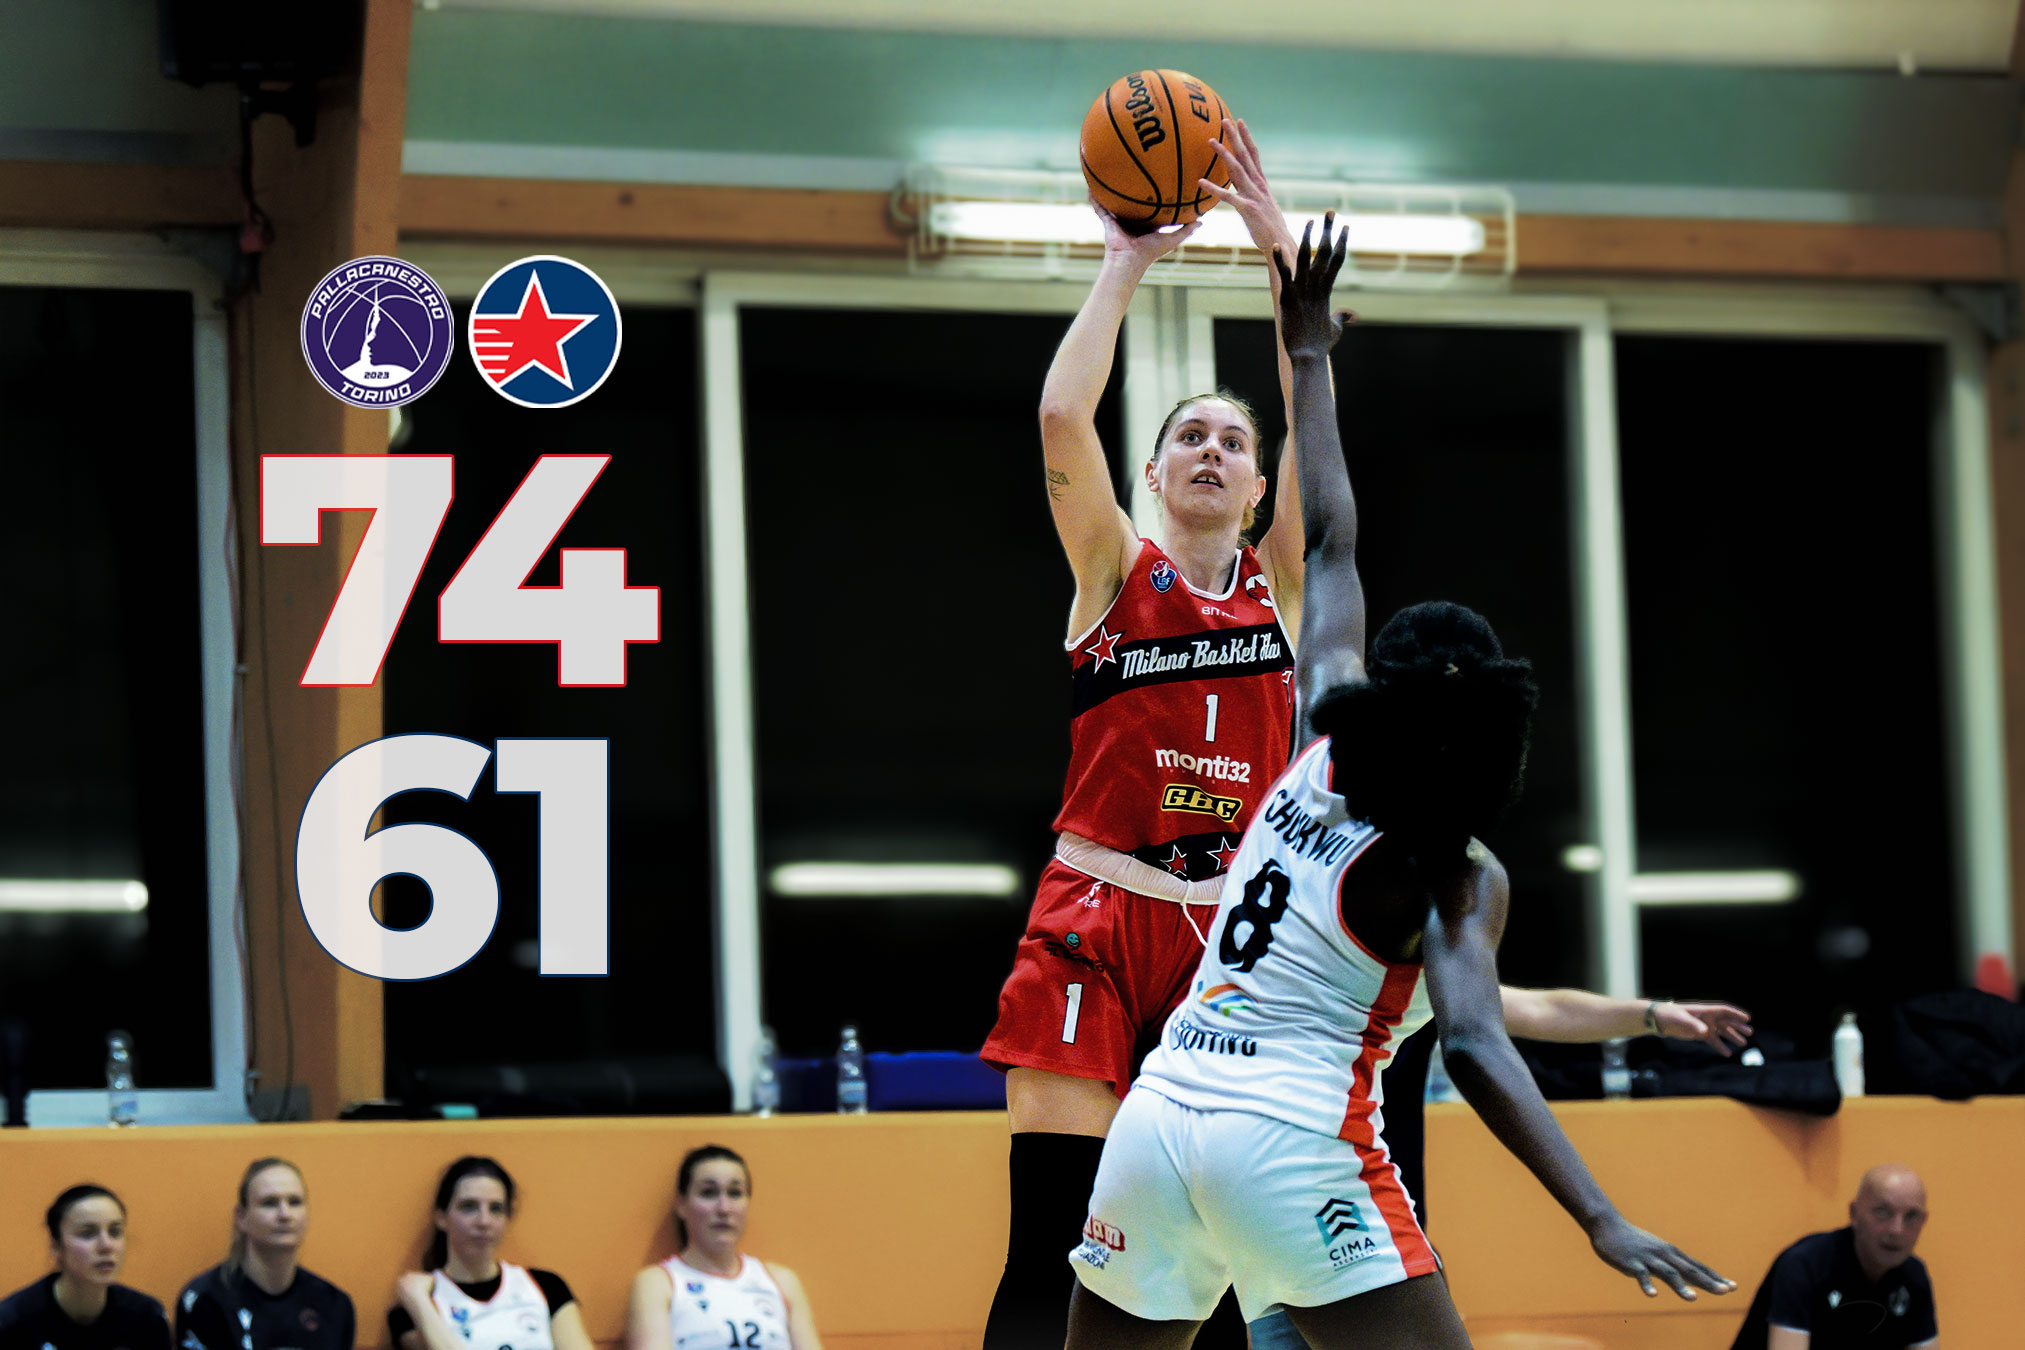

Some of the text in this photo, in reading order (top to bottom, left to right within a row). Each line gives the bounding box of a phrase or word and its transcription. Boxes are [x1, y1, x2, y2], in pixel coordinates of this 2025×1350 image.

[1121, 646, 1191, 680] Milano
[1205, 693, 1219, 742] 1
[1155, 749, 1251, 784] monti32
[1219, 858, 1291, 974] 8
[1061, 982, 1083, 1045] 1
[1329, 1237, 1376, 1261] CIMA
[725, 1320, 761, 1350] 12
